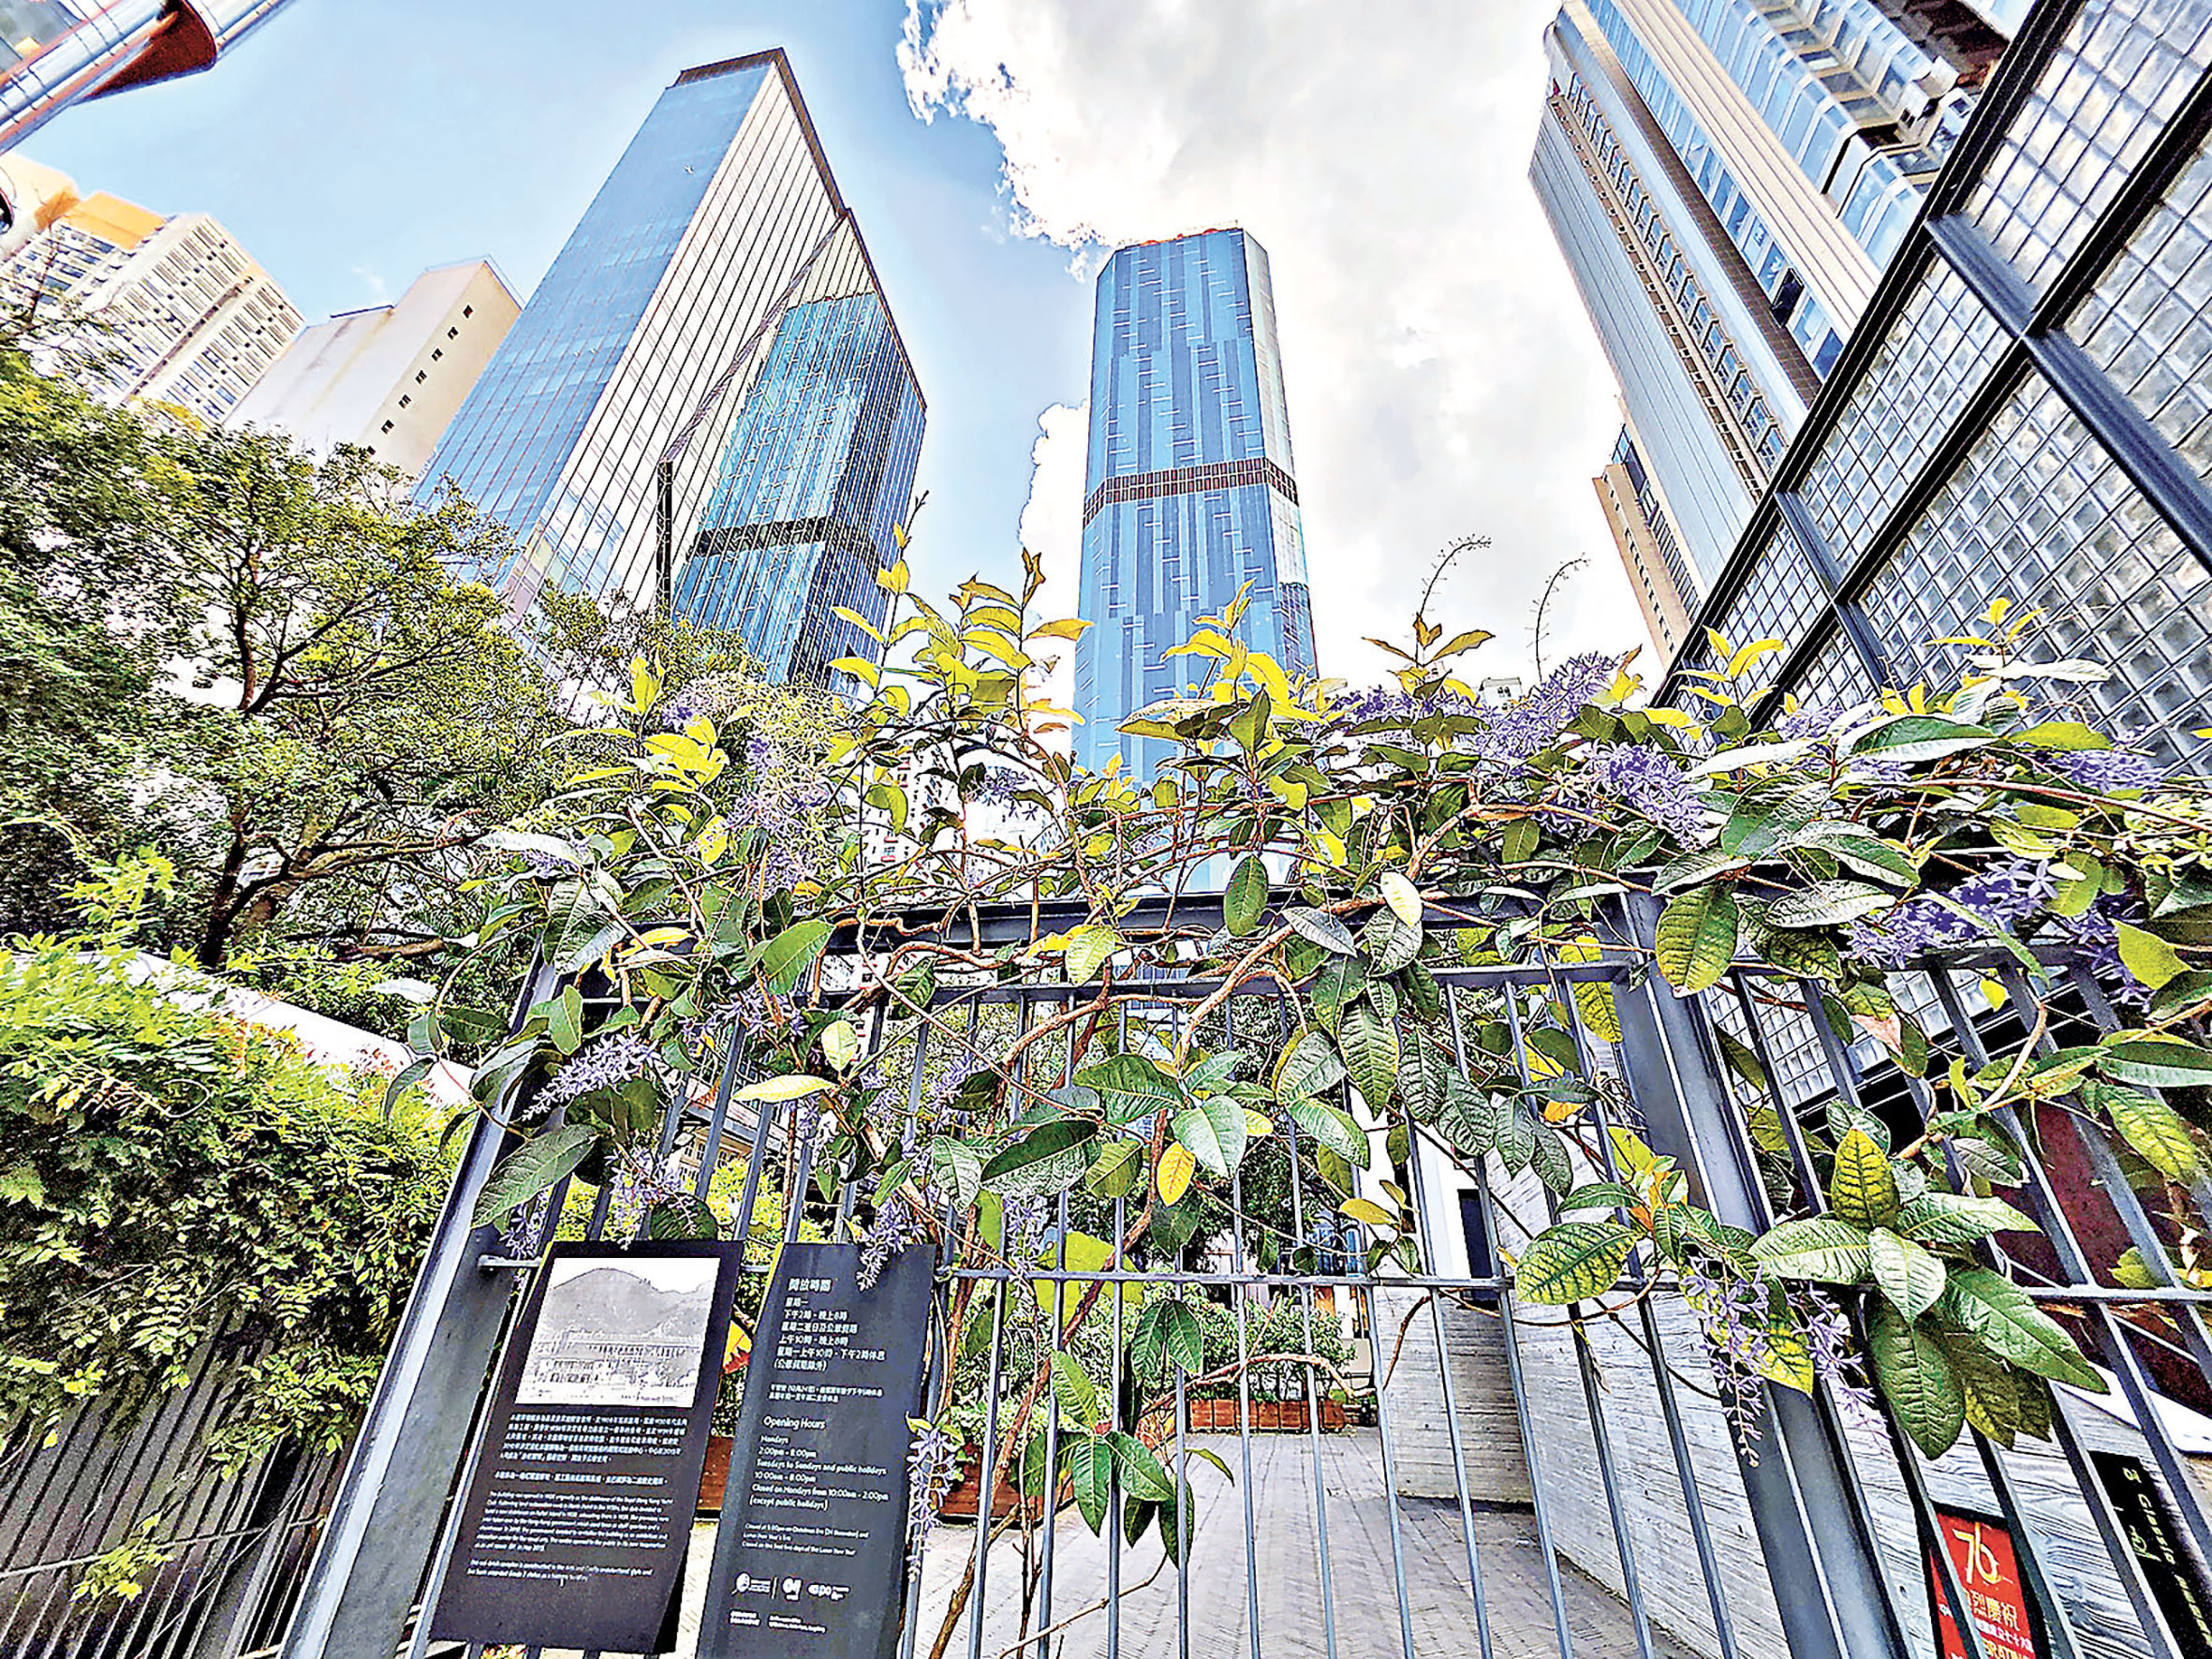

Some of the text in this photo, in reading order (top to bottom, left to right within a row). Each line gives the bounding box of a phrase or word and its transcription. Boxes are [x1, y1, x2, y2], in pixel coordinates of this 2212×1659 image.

[763, 1415, 826, 1430] Opening Hours
[760, 1436, 789, 1445] Mondays
[757, 1459, 887, 1477] Tuesdays to Sundays and public holidays
[752, 1484, 774, 1493] Closed
[783, 1486, 812, 1497] Mondays
[812, 1488, 827, 1497] from
[774, 1498, 796, 1508] public
[1952, 1521, 2000, 1585] 76
[1964, 1588, 2021, 1632] 烈慶祝
